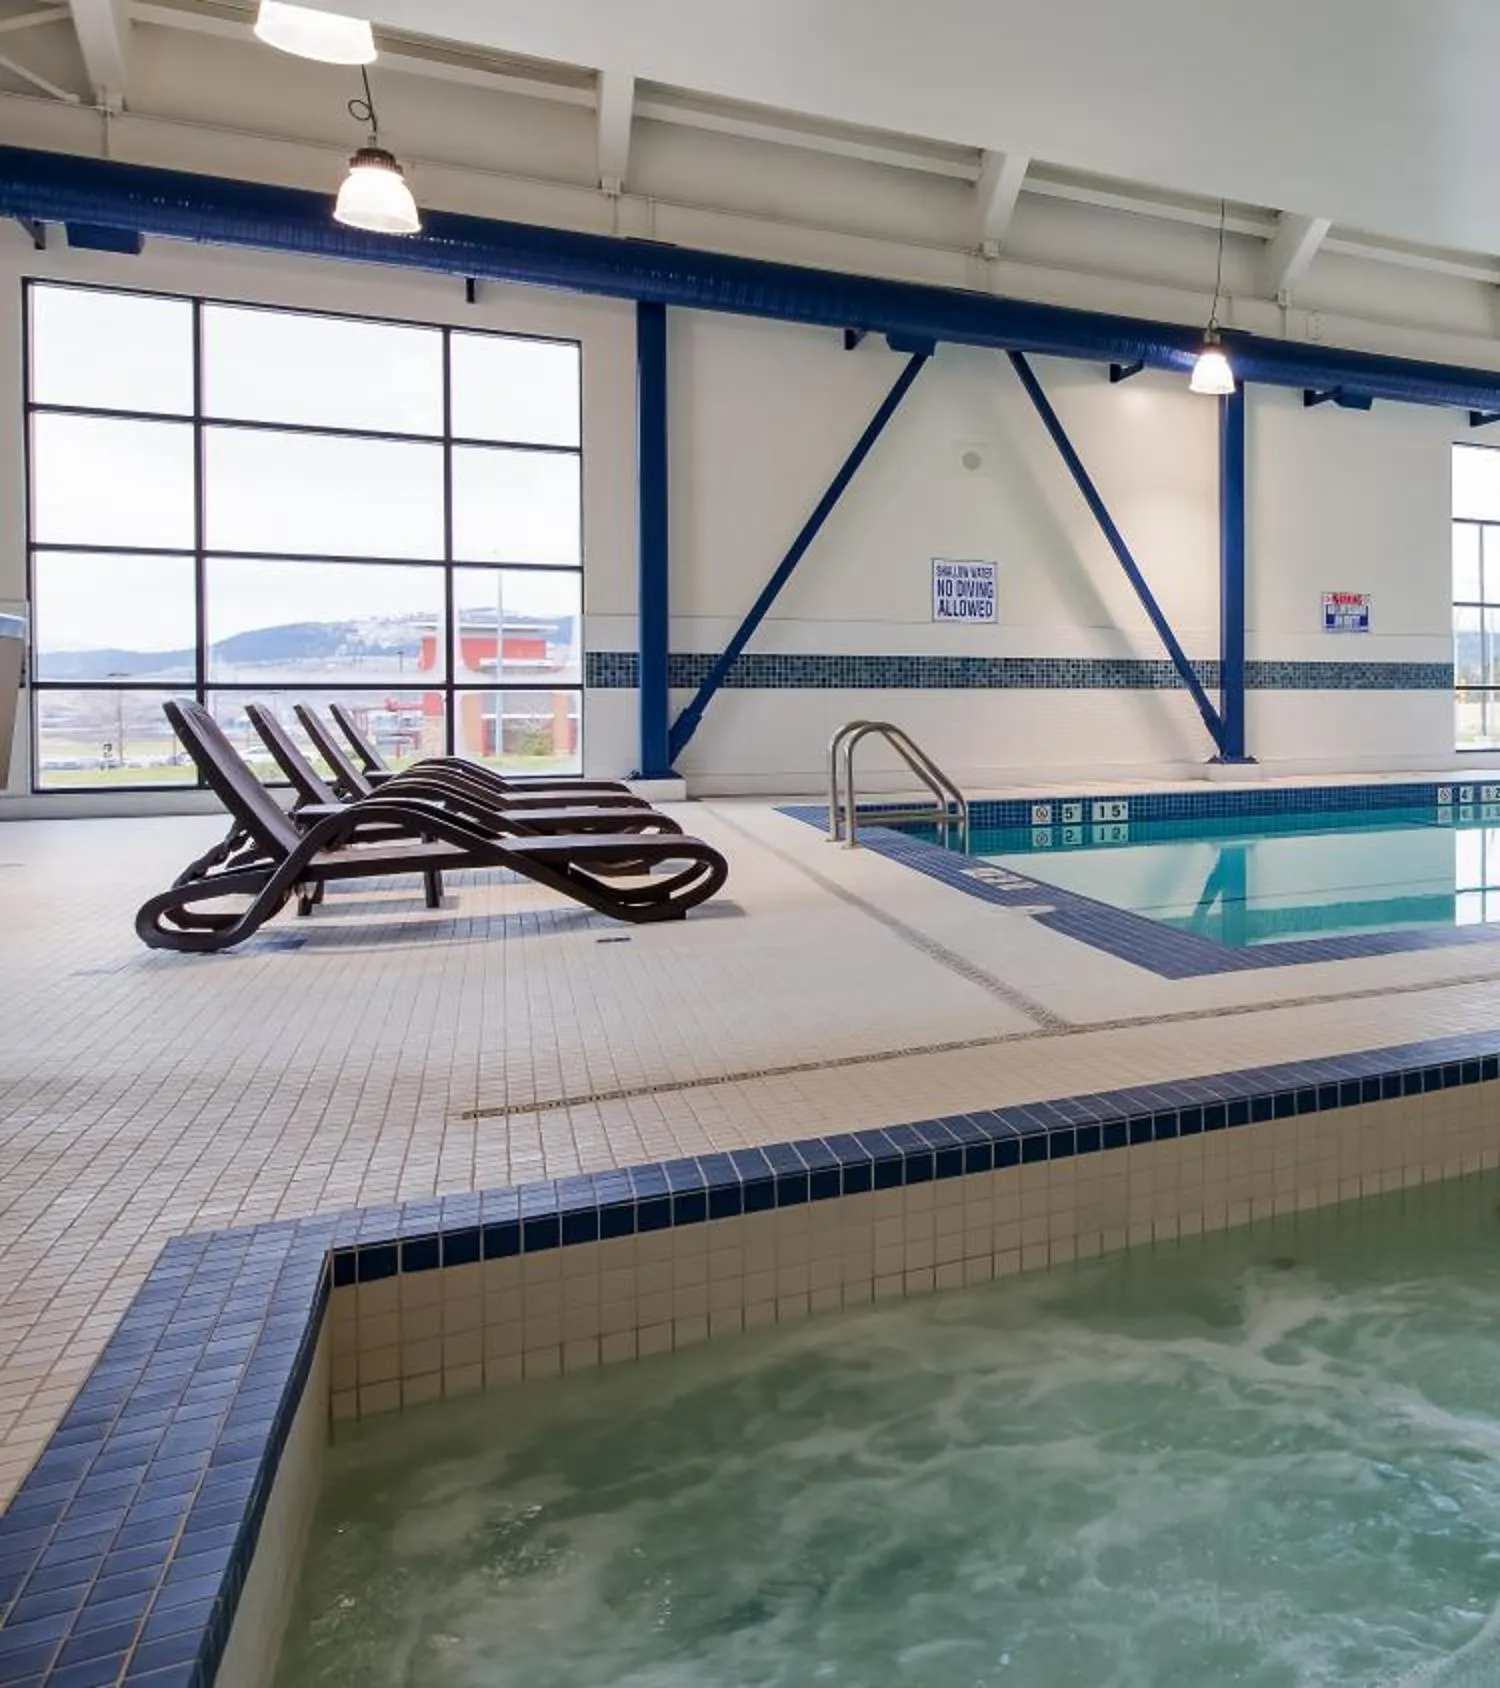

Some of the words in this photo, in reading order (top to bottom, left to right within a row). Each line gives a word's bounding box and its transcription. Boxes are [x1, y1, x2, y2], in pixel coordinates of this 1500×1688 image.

[937, 579, 953, 597] NO
[956, 580, 994, 599] DIVING
[938, 599, 993, 618] ALLOWED
